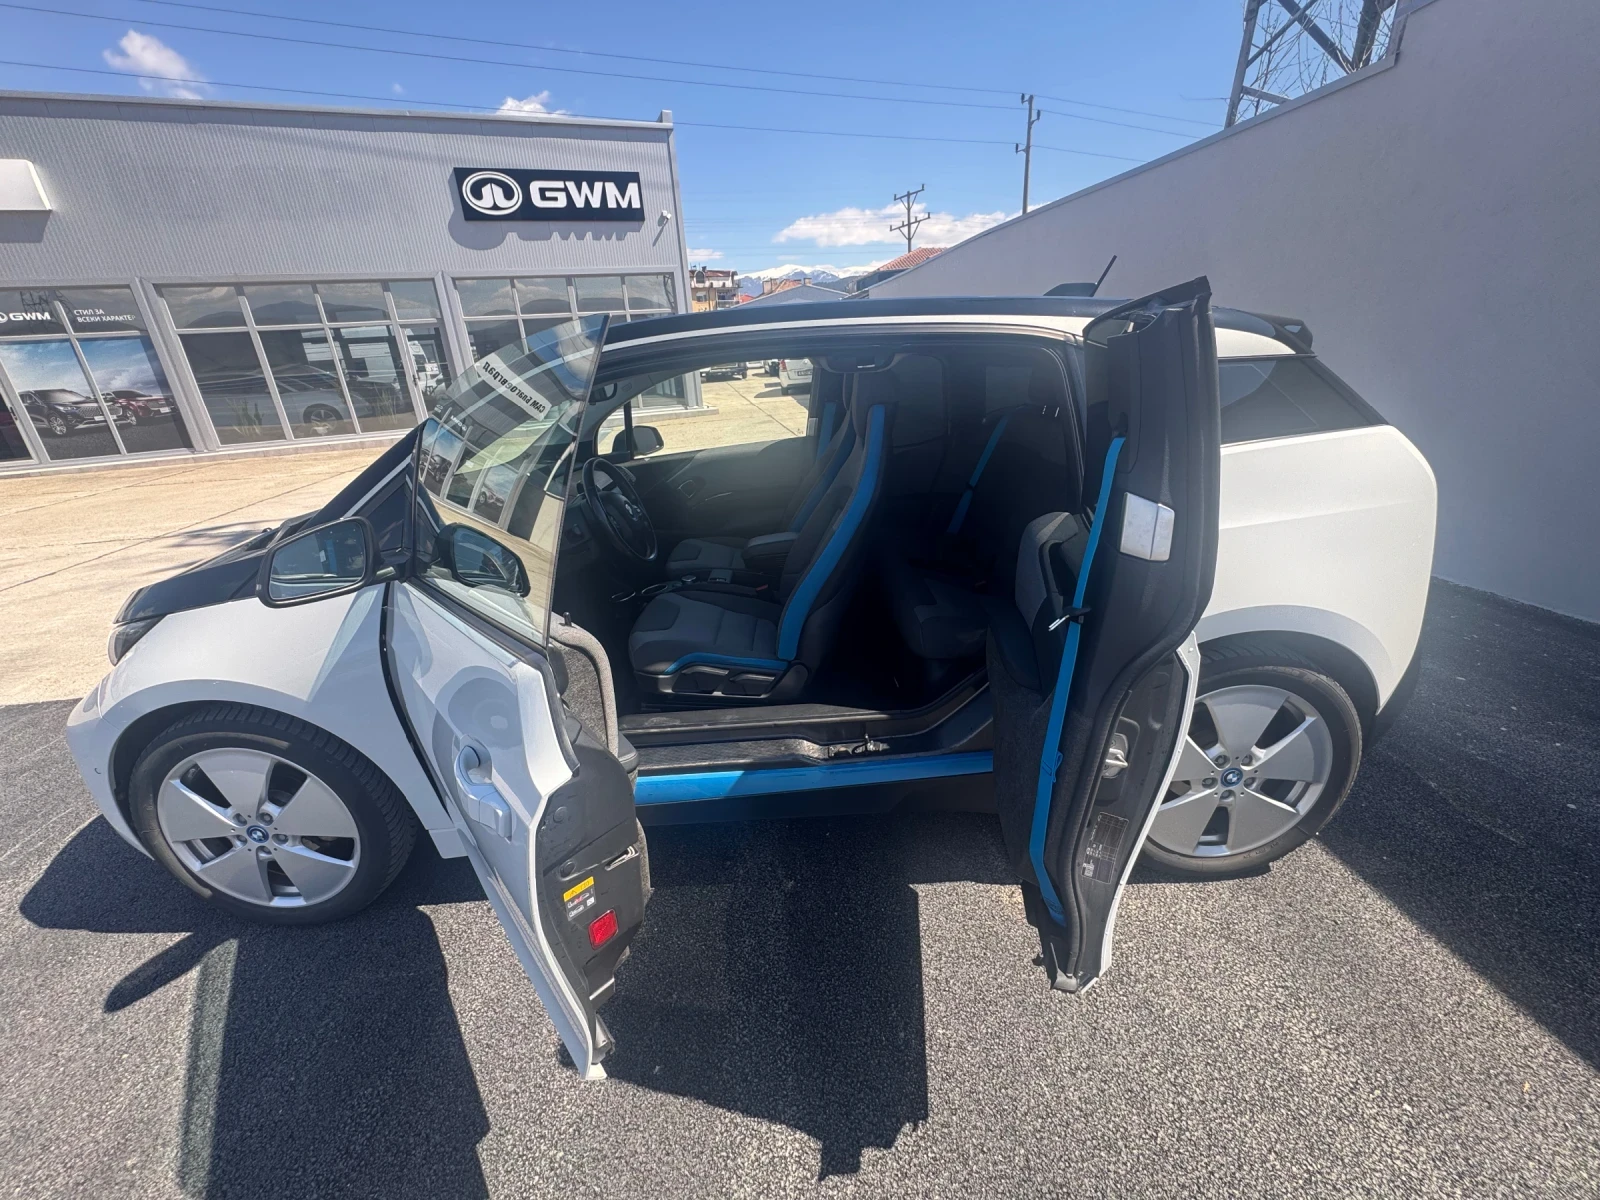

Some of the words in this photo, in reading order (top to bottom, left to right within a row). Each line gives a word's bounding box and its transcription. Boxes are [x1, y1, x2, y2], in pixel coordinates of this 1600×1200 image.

[529, 180, 641, 209] GWM
[8, 312, 51, 321] GWM
[76, 315, 101, 323] ВСЕКИ
[101, 314, 136, 322] ХАРАКТЕР
